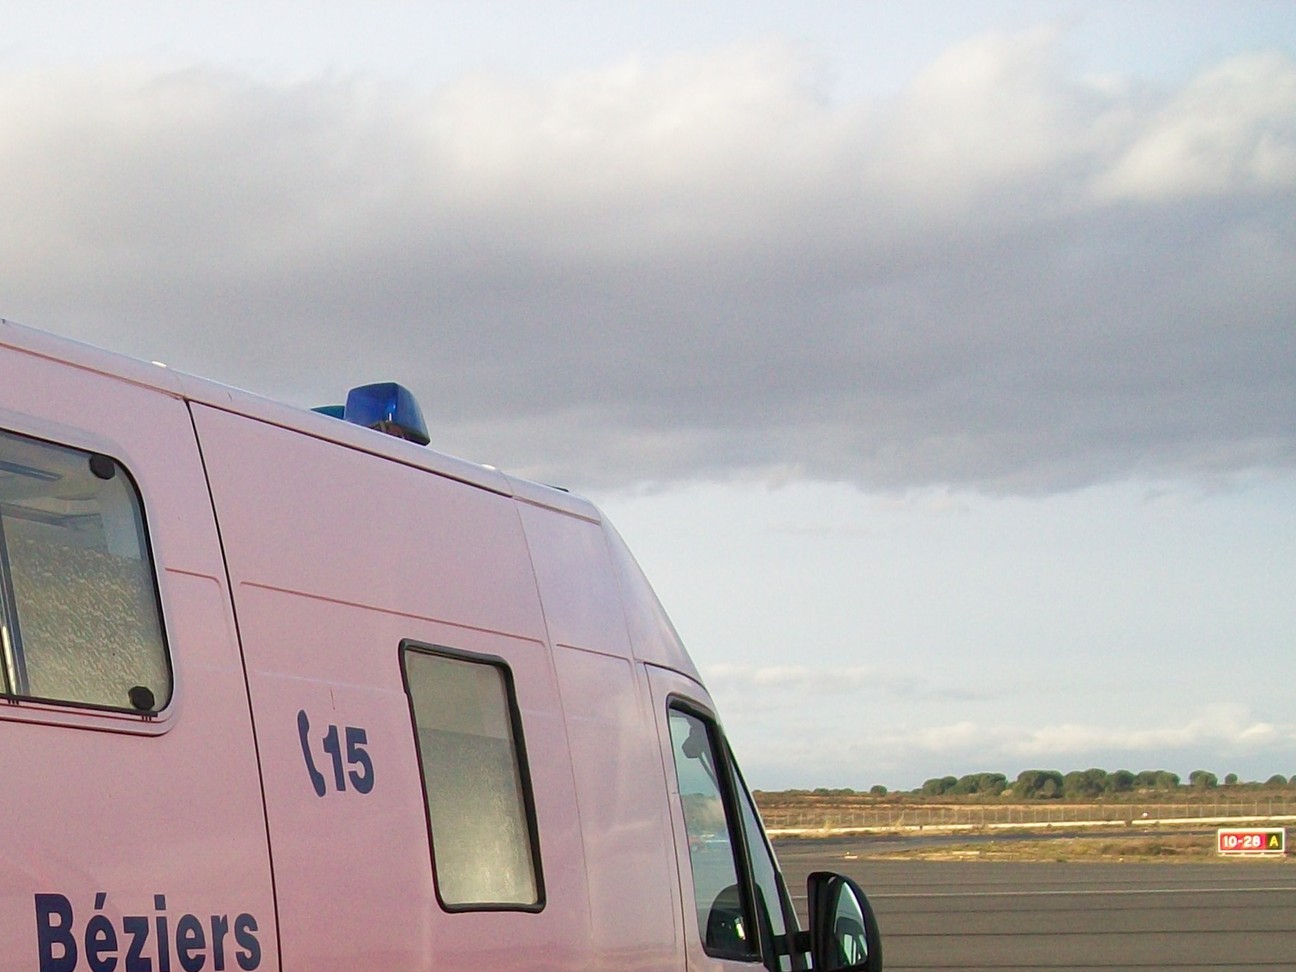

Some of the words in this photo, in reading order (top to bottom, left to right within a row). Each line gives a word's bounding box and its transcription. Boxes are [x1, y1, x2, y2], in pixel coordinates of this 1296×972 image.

[321, 724, 375, 795] 15
[1223, 835, 1261, 847] 10-28
[1269, 835, 1279, 847] A
